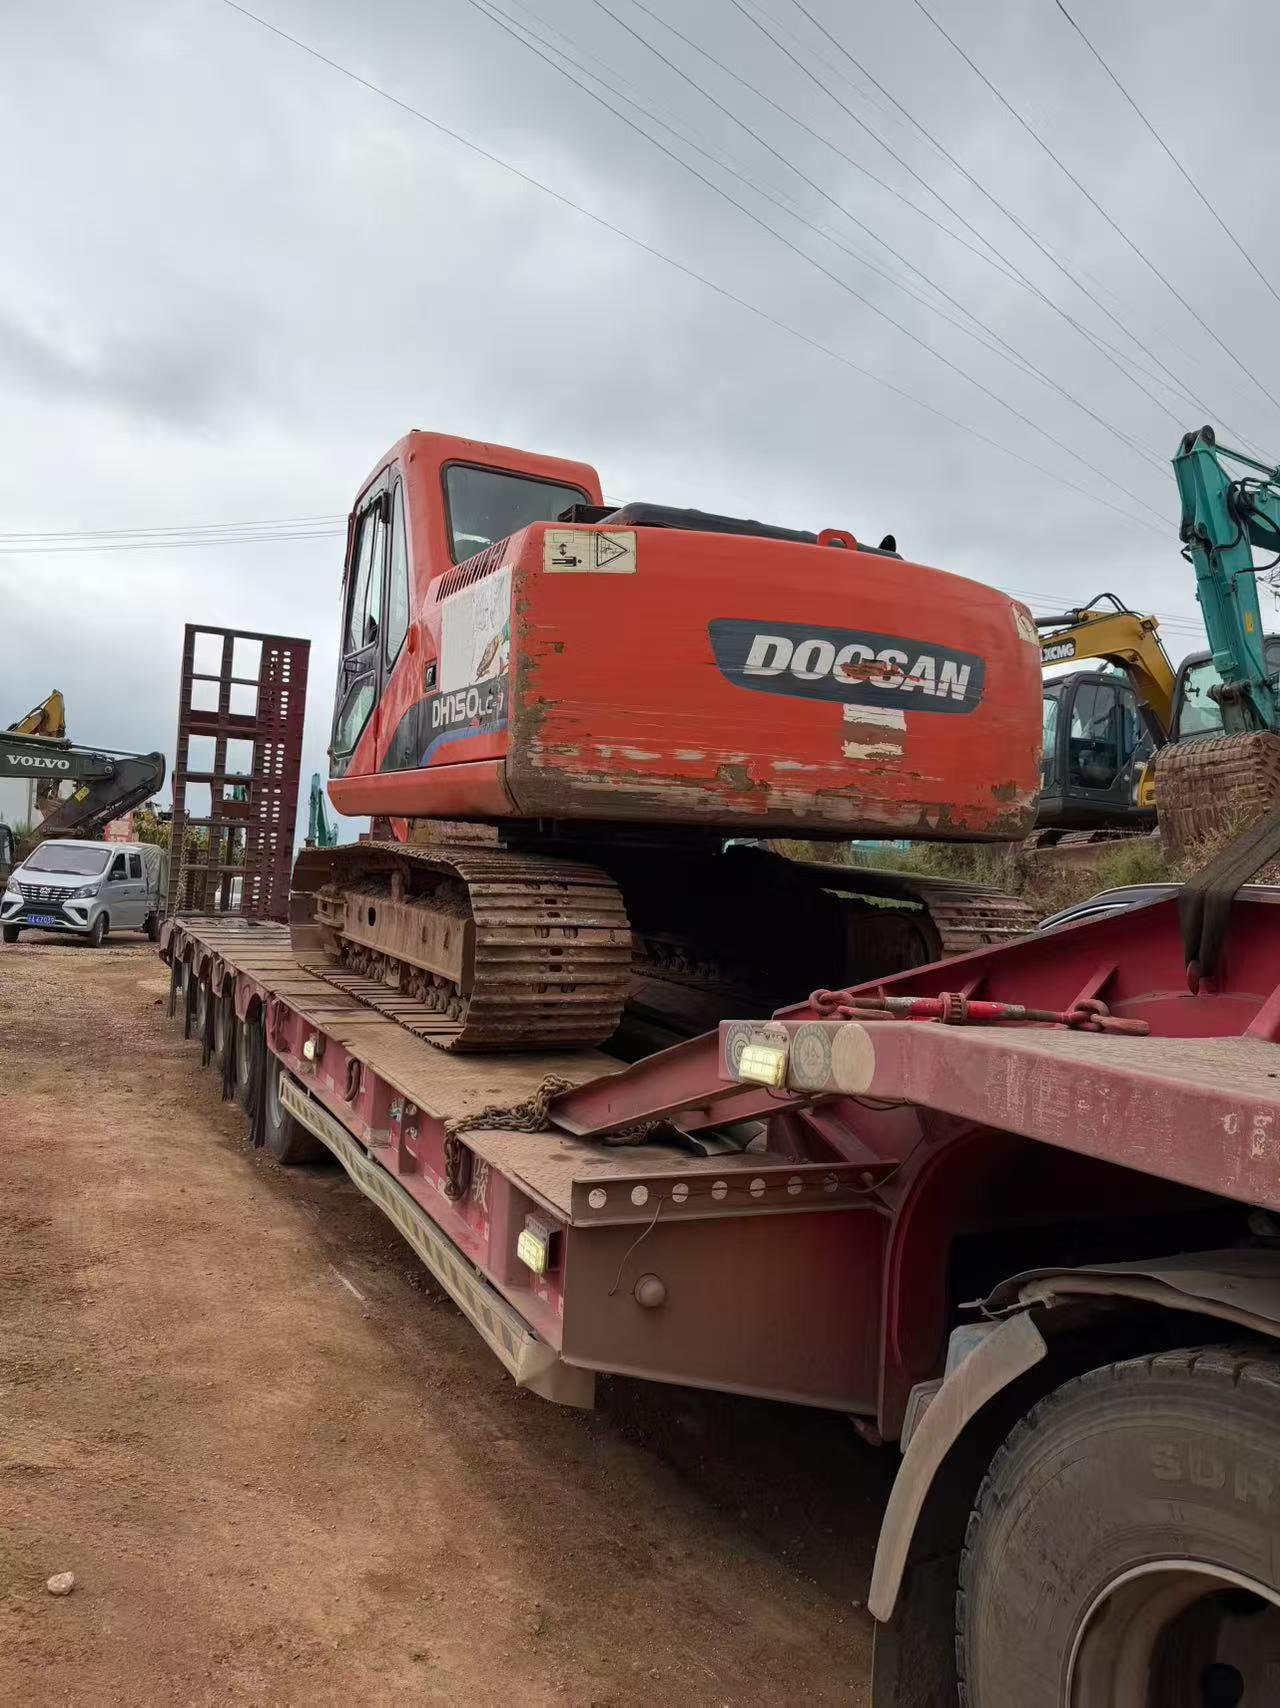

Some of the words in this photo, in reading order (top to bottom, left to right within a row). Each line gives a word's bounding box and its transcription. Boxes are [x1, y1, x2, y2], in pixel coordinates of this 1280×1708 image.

[1043, 643, 1075, 661] XCMG
[742, 634, 971, 701] DOOSAN
[6, 754, 70, 769] VOLVO
